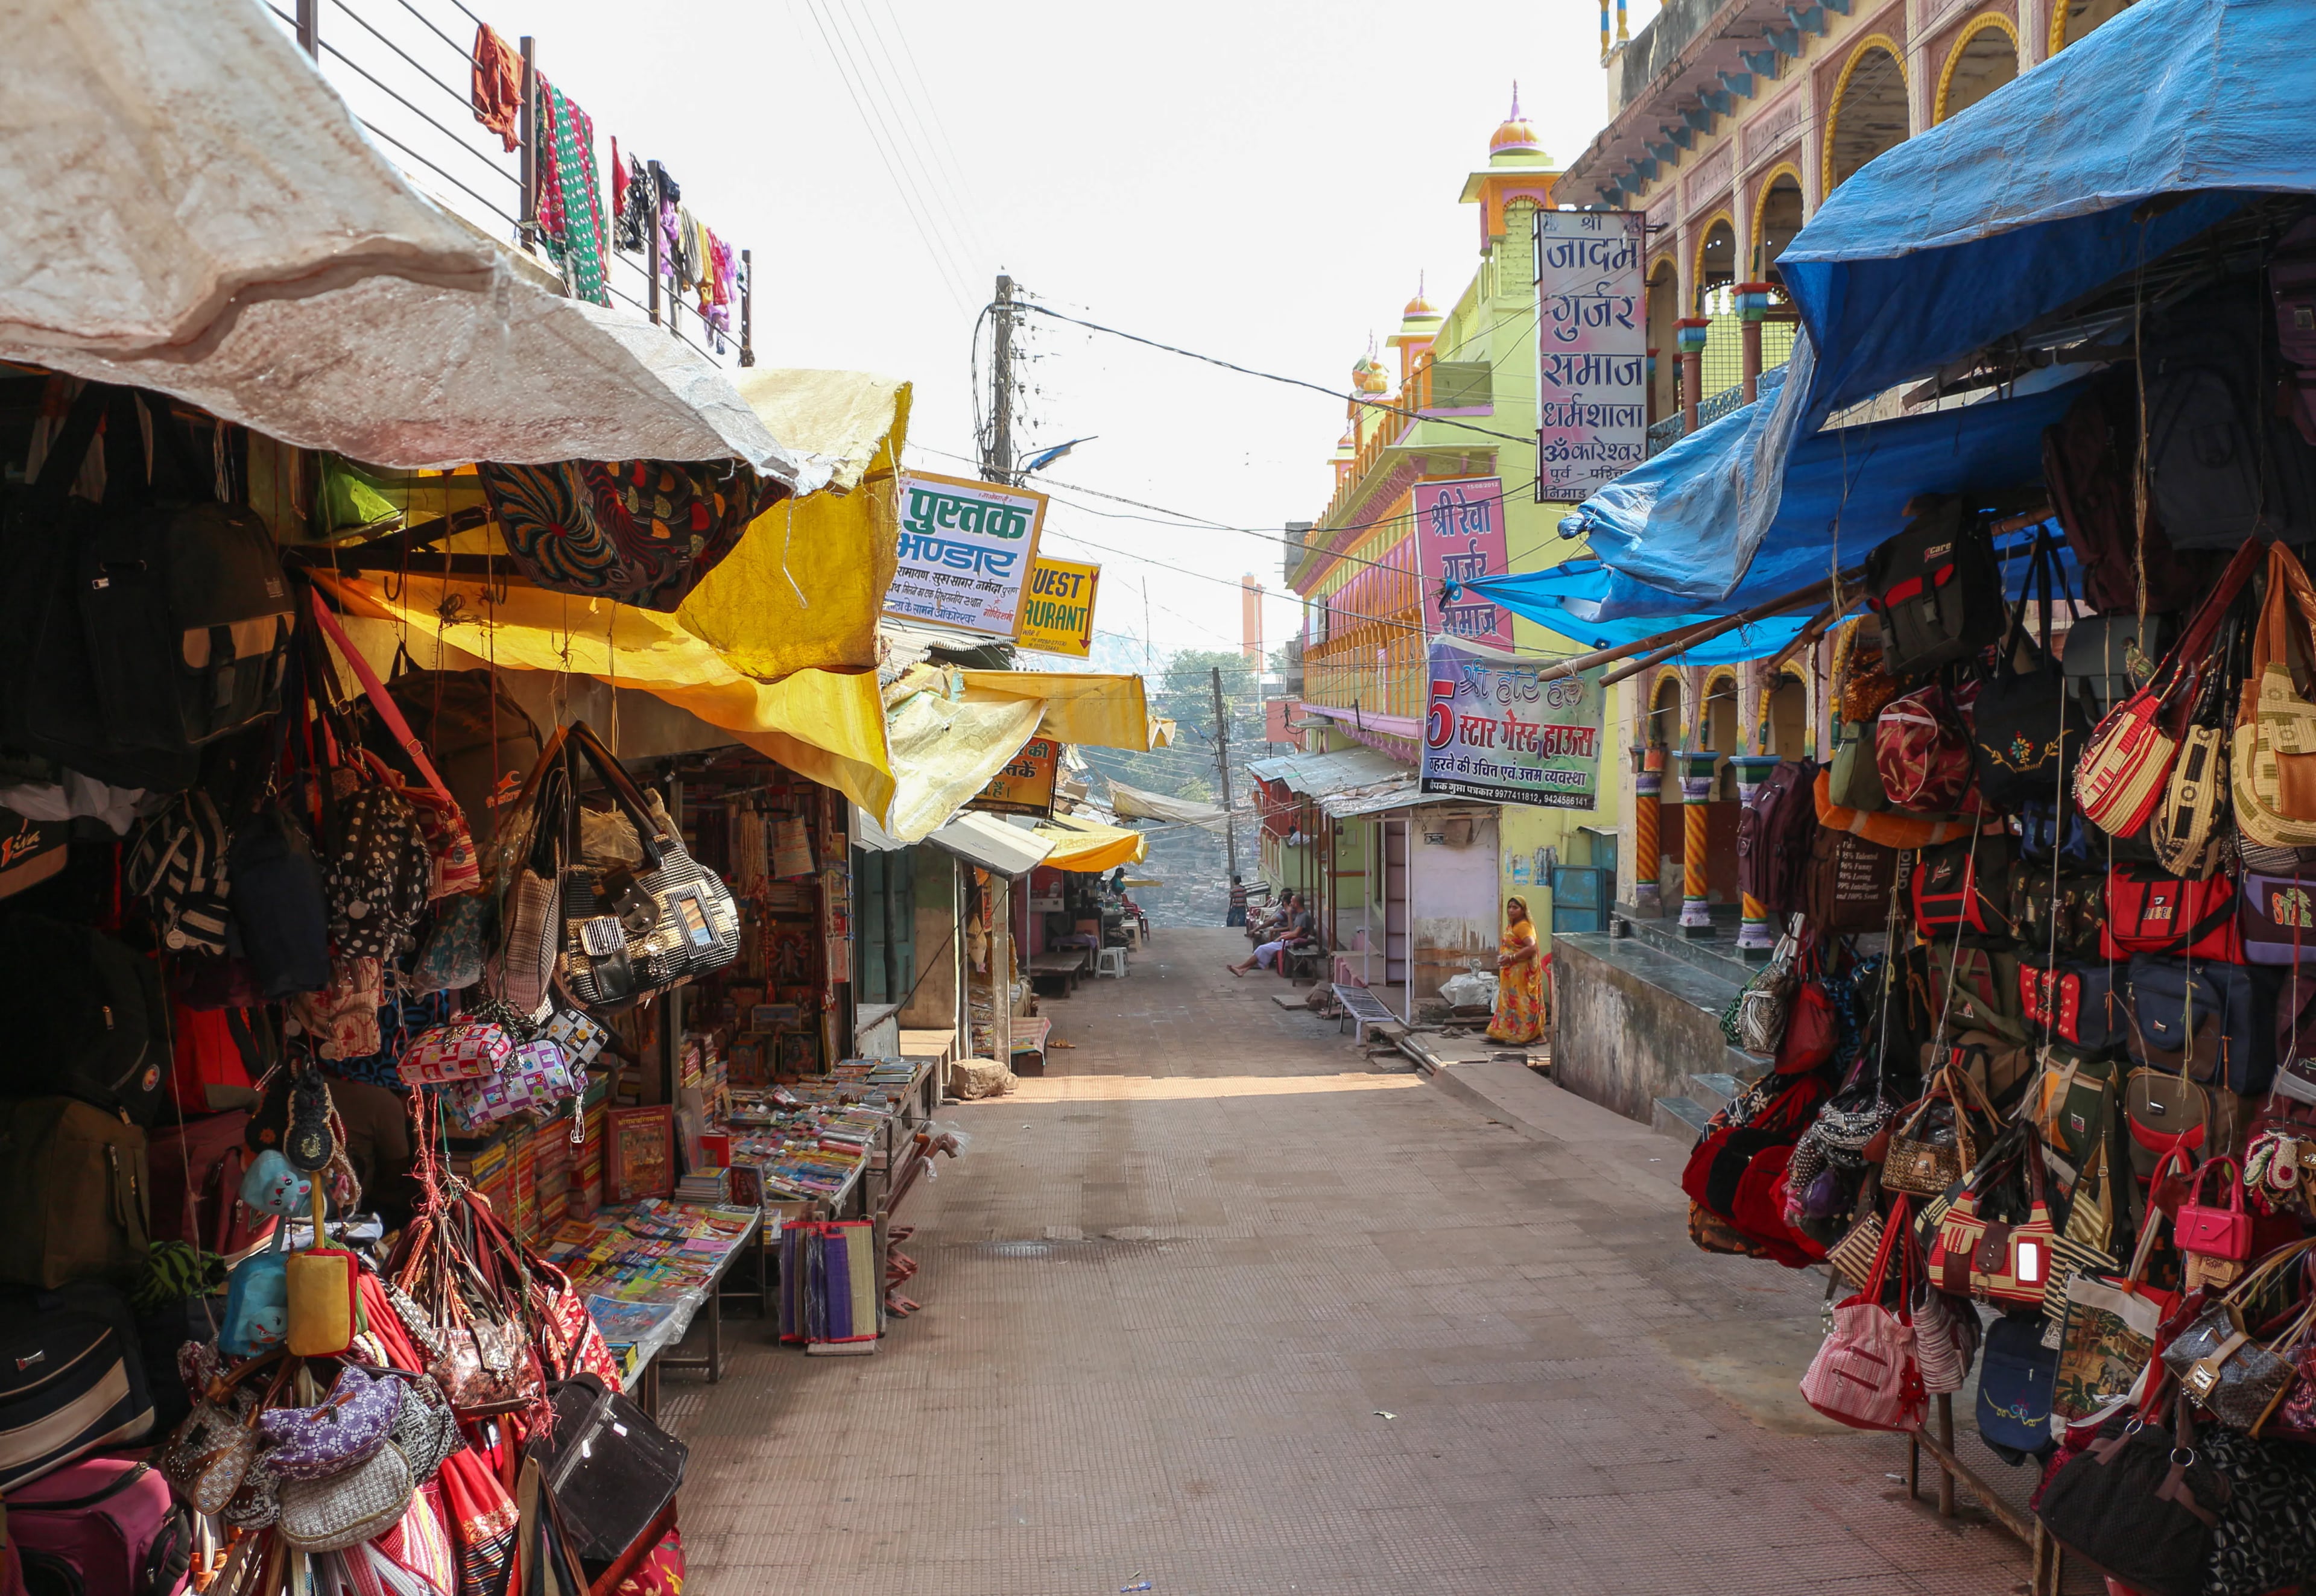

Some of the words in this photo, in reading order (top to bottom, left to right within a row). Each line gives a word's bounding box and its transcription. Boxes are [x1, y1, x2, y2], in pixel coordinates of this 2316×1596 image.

[1581, 212, 1602, 230] श्री
[1551, 281, 1636, 342] गुर्जर
[1543, 353, 1645, 387] समाज
[1543, 393, 1645, 429] धर्मशाला
[1544, 484, 1587, 499] निमाड
[903, 487, 1033, 539] पुस्तक
[1431, 489, 1455, 537] श्री
[1456, 487, 1492, 535] रेवा
[897, 532, 1017, 578] भण्डार
[975, 578, 1002, 595] नर्मदा
[1033, 567, 1085, 599] UEST
[1440, 602, 1497, 637] समाज
[1460, 658, 1491, 699] श्री
[1427, 679, 1455, 749] 5
[1459, 714, 1498, 748] स्टार
[1501, 708, 1540, 753] गेस्ट
[1028, 742, 1049, 759] की
[1429, 752, 1455, 773] ठहरने
[1457, 755, 1470, 774] की
[1472, 758, 1498, 778] उचित
[1545, 769, 1587, 786] व्यवस्था
[1467, 786, 1493, 797] पत्रकार
[1544, 794, 1587, 806] 9424586141
[2143, 906, 2172, 920] DIESEL
